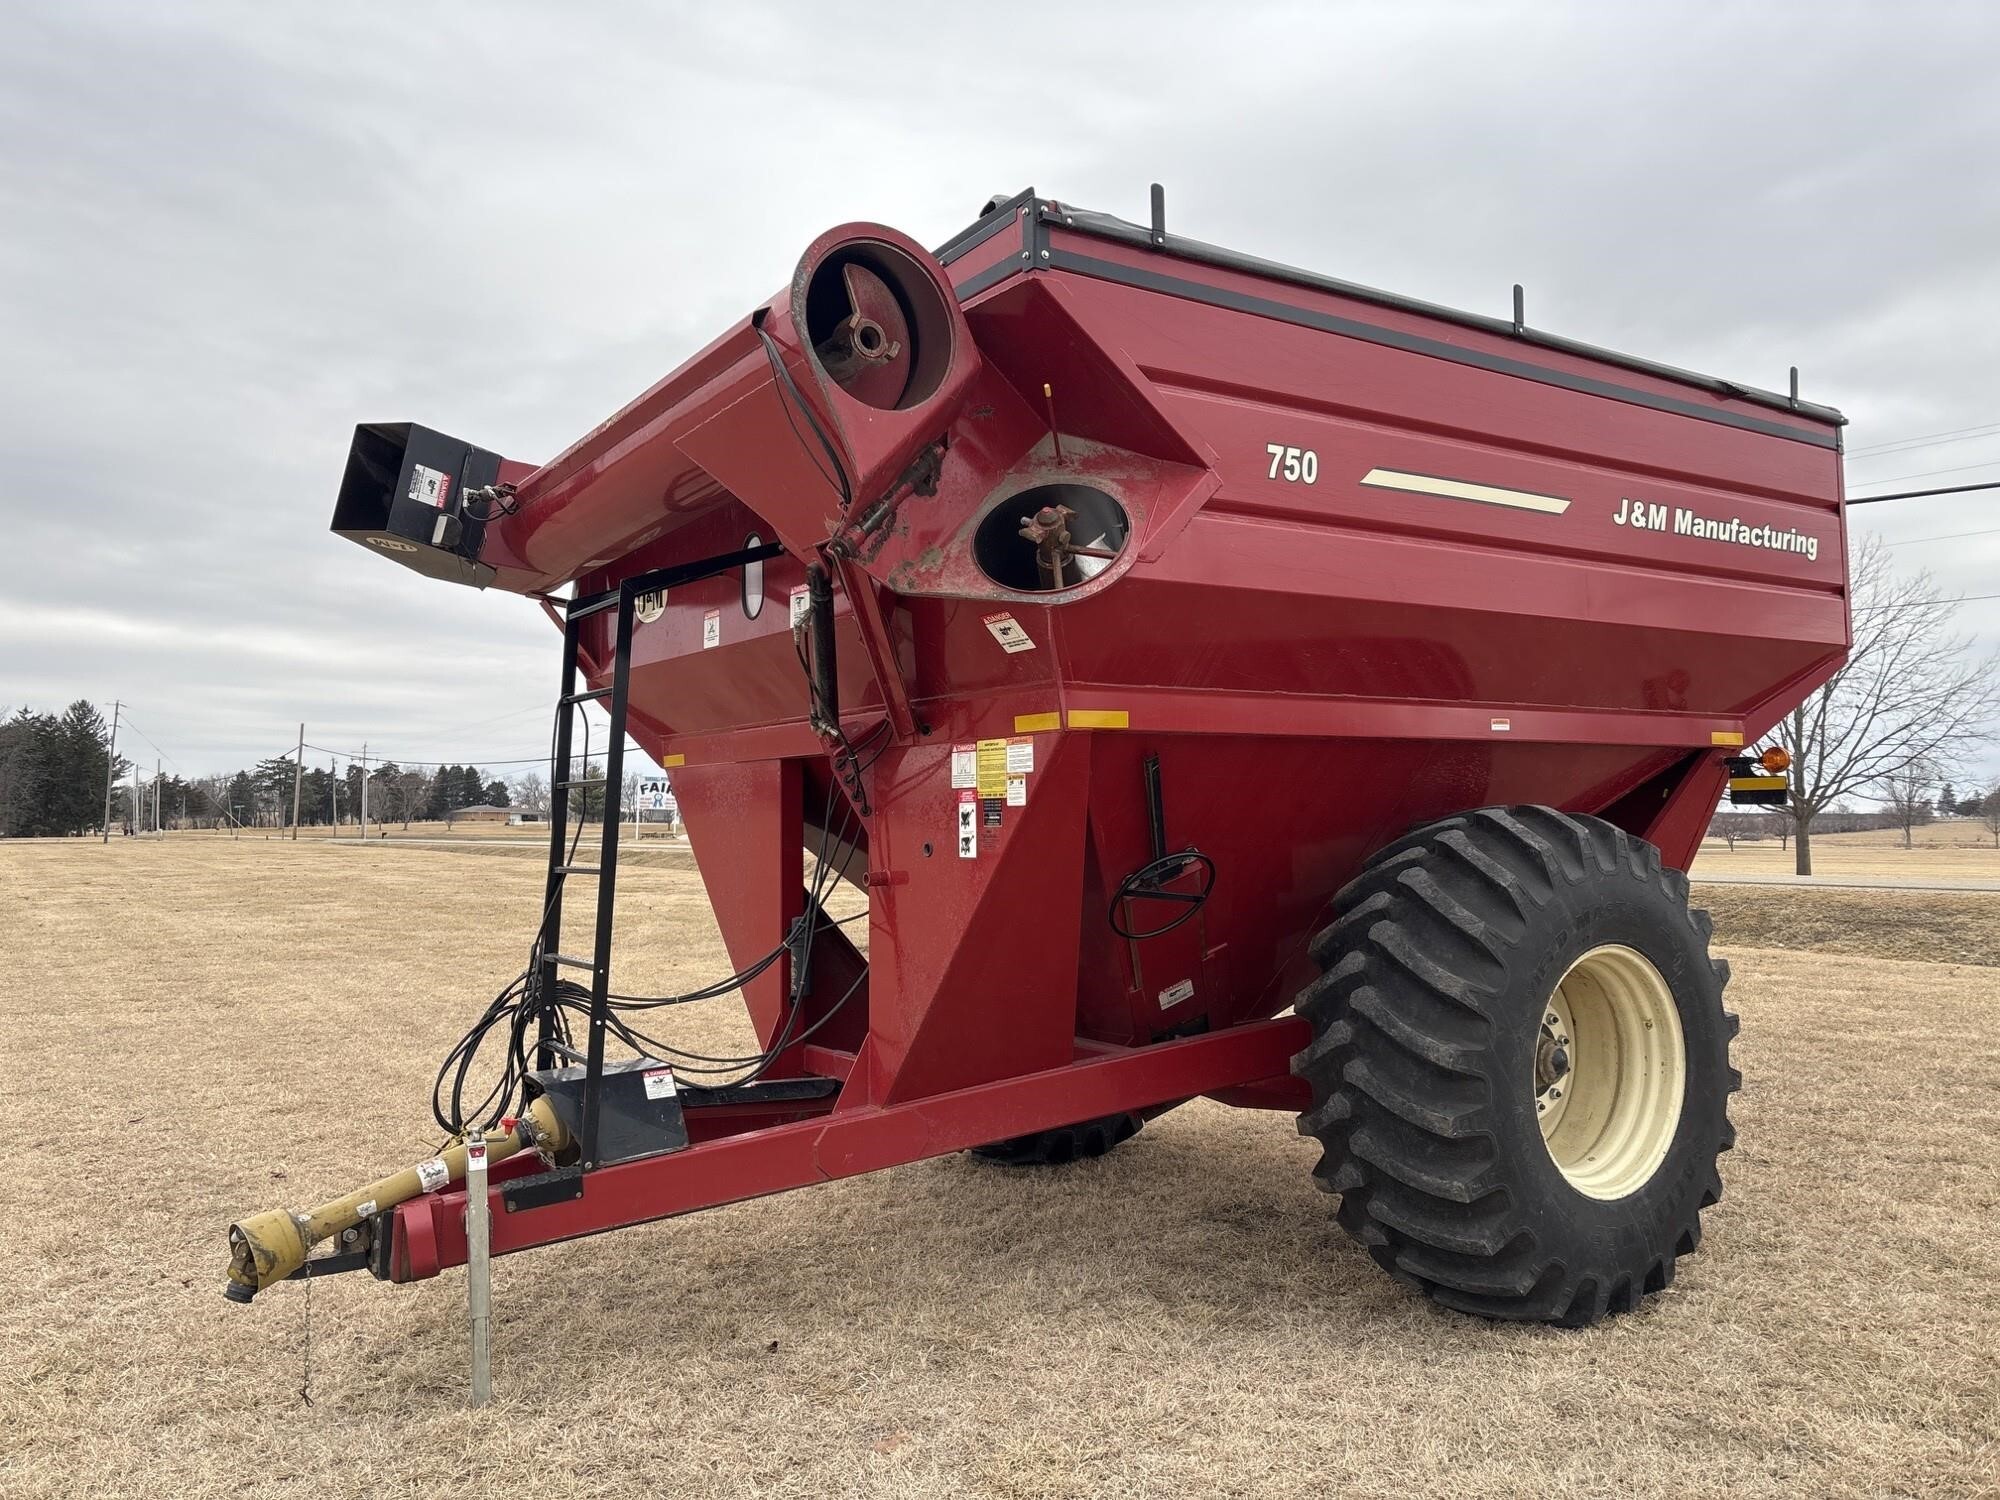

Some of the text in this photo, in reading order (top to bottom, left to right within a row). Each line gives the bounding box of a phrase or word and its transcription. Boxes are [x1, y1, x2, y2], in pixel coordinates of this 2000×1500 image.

[1266, 443, 1318, 485] 750
[1612, 498, 1819, 562] J&M Manufacturing
[986, 611, 1012, 623] DANGER
[957, 743, 976, 752] DANGER
[650, 1069, 671, 1077] DANGER
